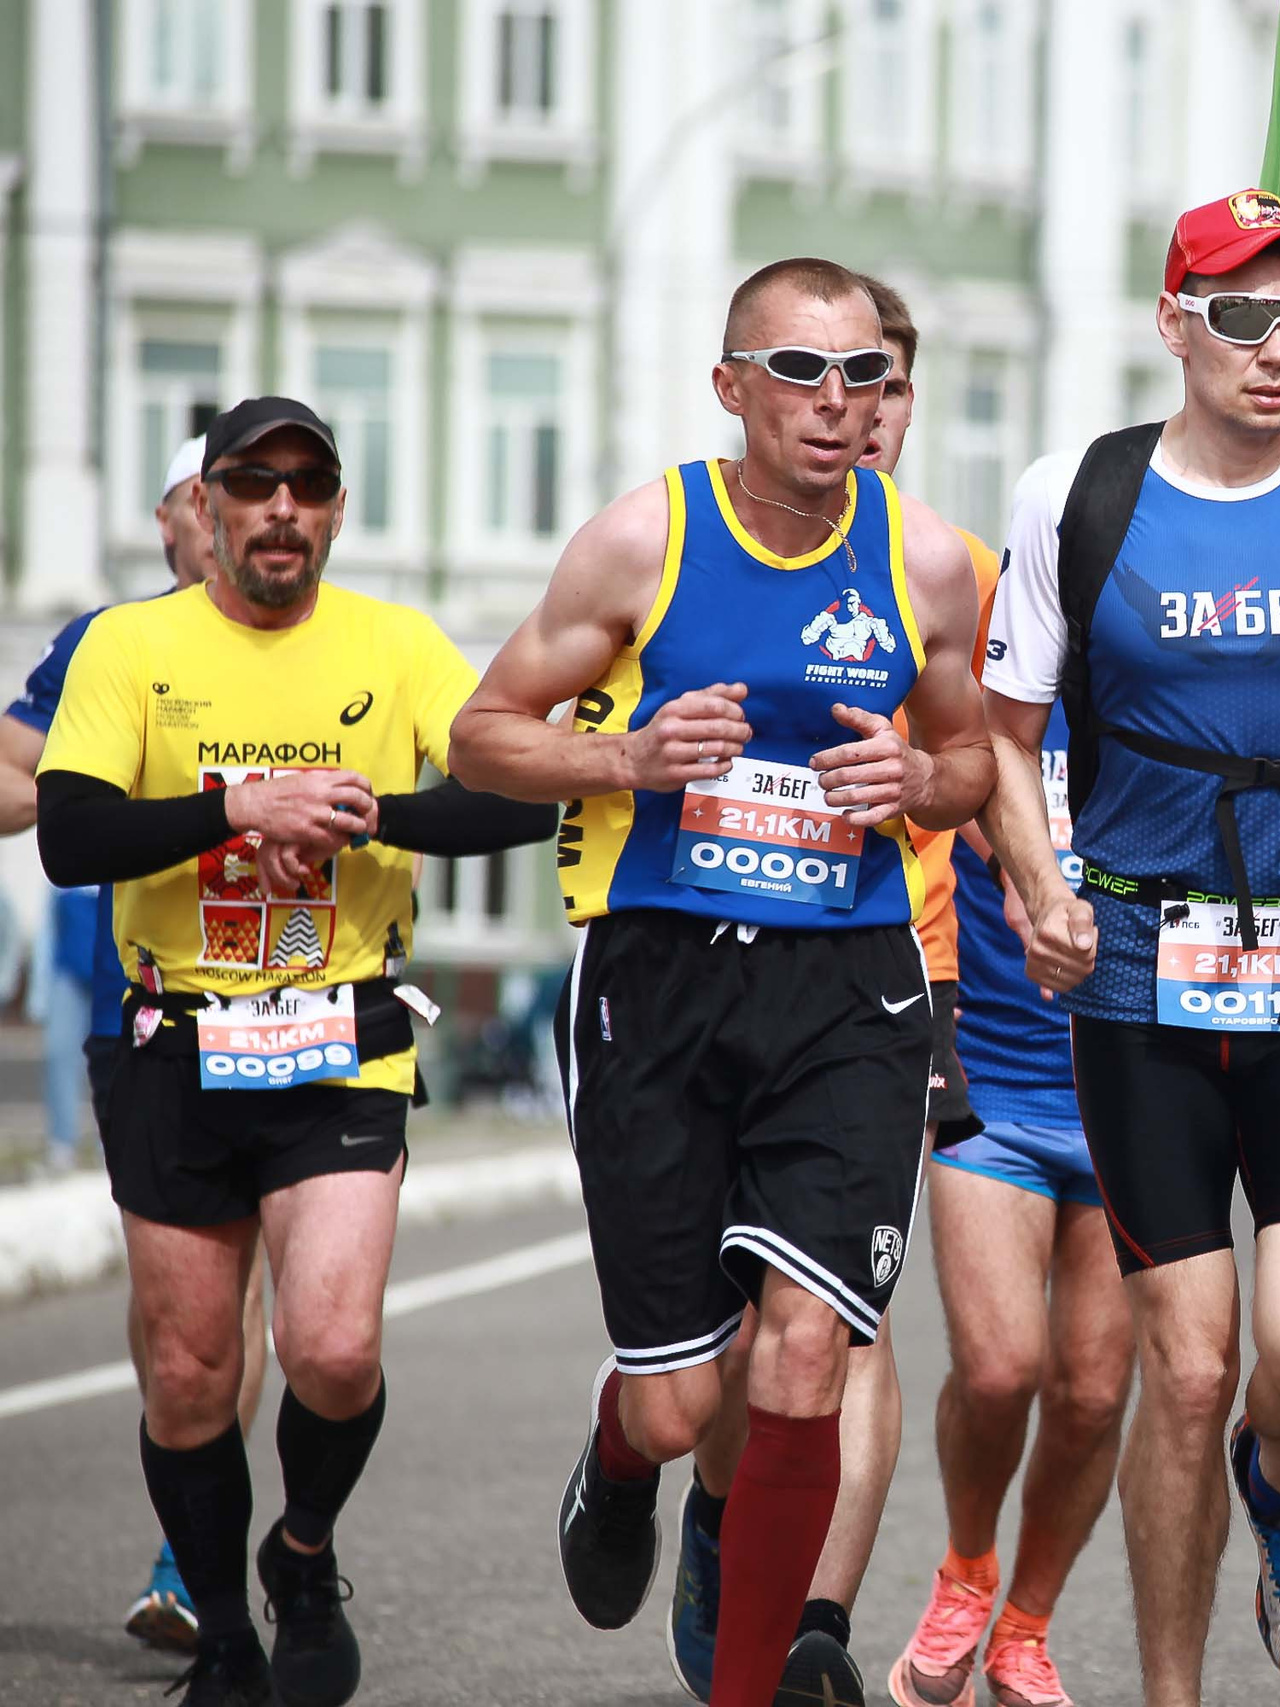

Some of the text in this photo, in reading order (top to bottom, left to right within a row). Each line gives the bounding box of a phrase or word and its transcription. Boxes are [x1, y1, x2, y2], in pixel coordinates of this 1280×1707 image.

[805, 664, 889, 681] FIGHT WORLD
[199, 742, 341, 763] МАРАФОН
[690, 842, 848, 889] 00001
[740, 878, 792, 893] ЕВГЕНИЙ
